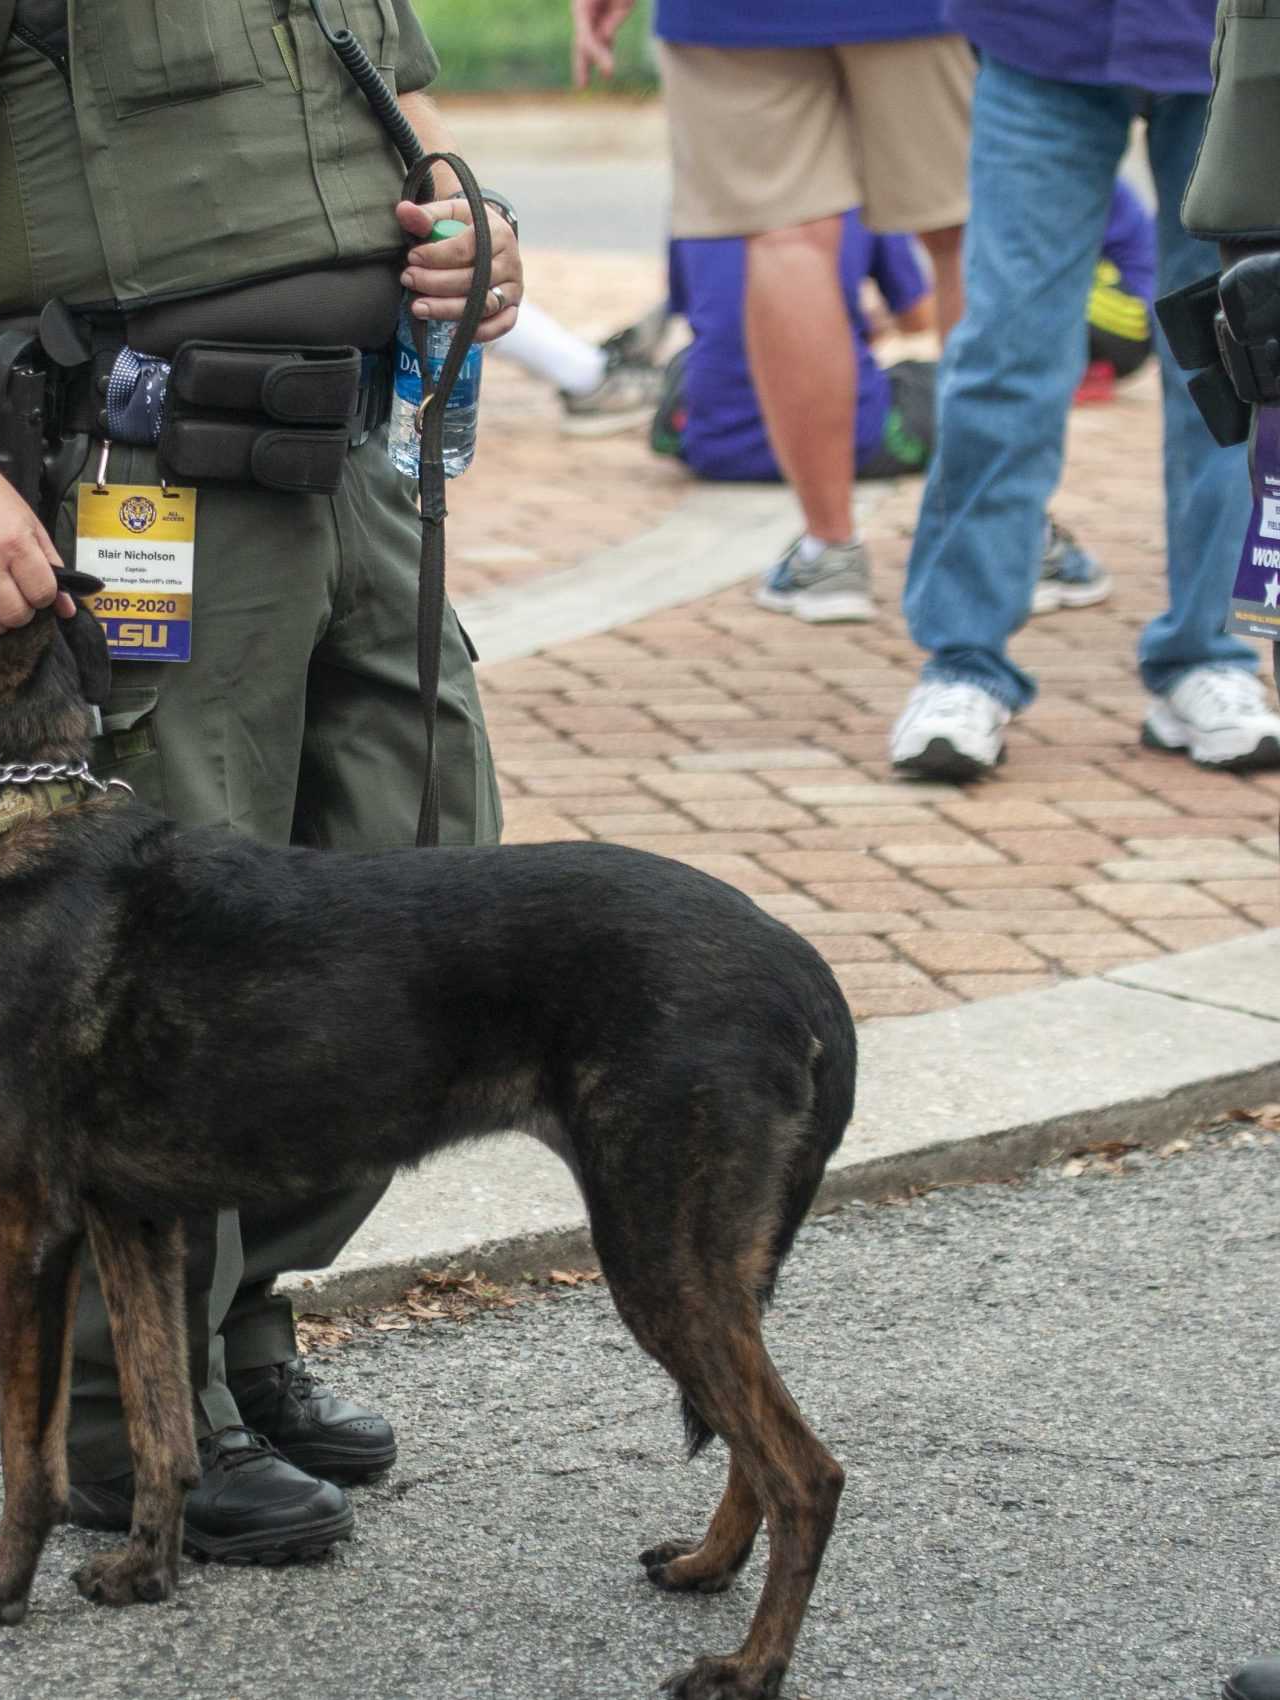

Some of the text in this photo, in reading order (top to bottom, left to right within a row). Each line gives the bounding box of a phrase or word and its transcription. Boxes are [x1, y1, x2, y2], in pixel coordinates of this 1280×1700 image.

[98, 549, 176, 561] Blair Nicholson
[93, 598, 177, 614] 2019-2020
